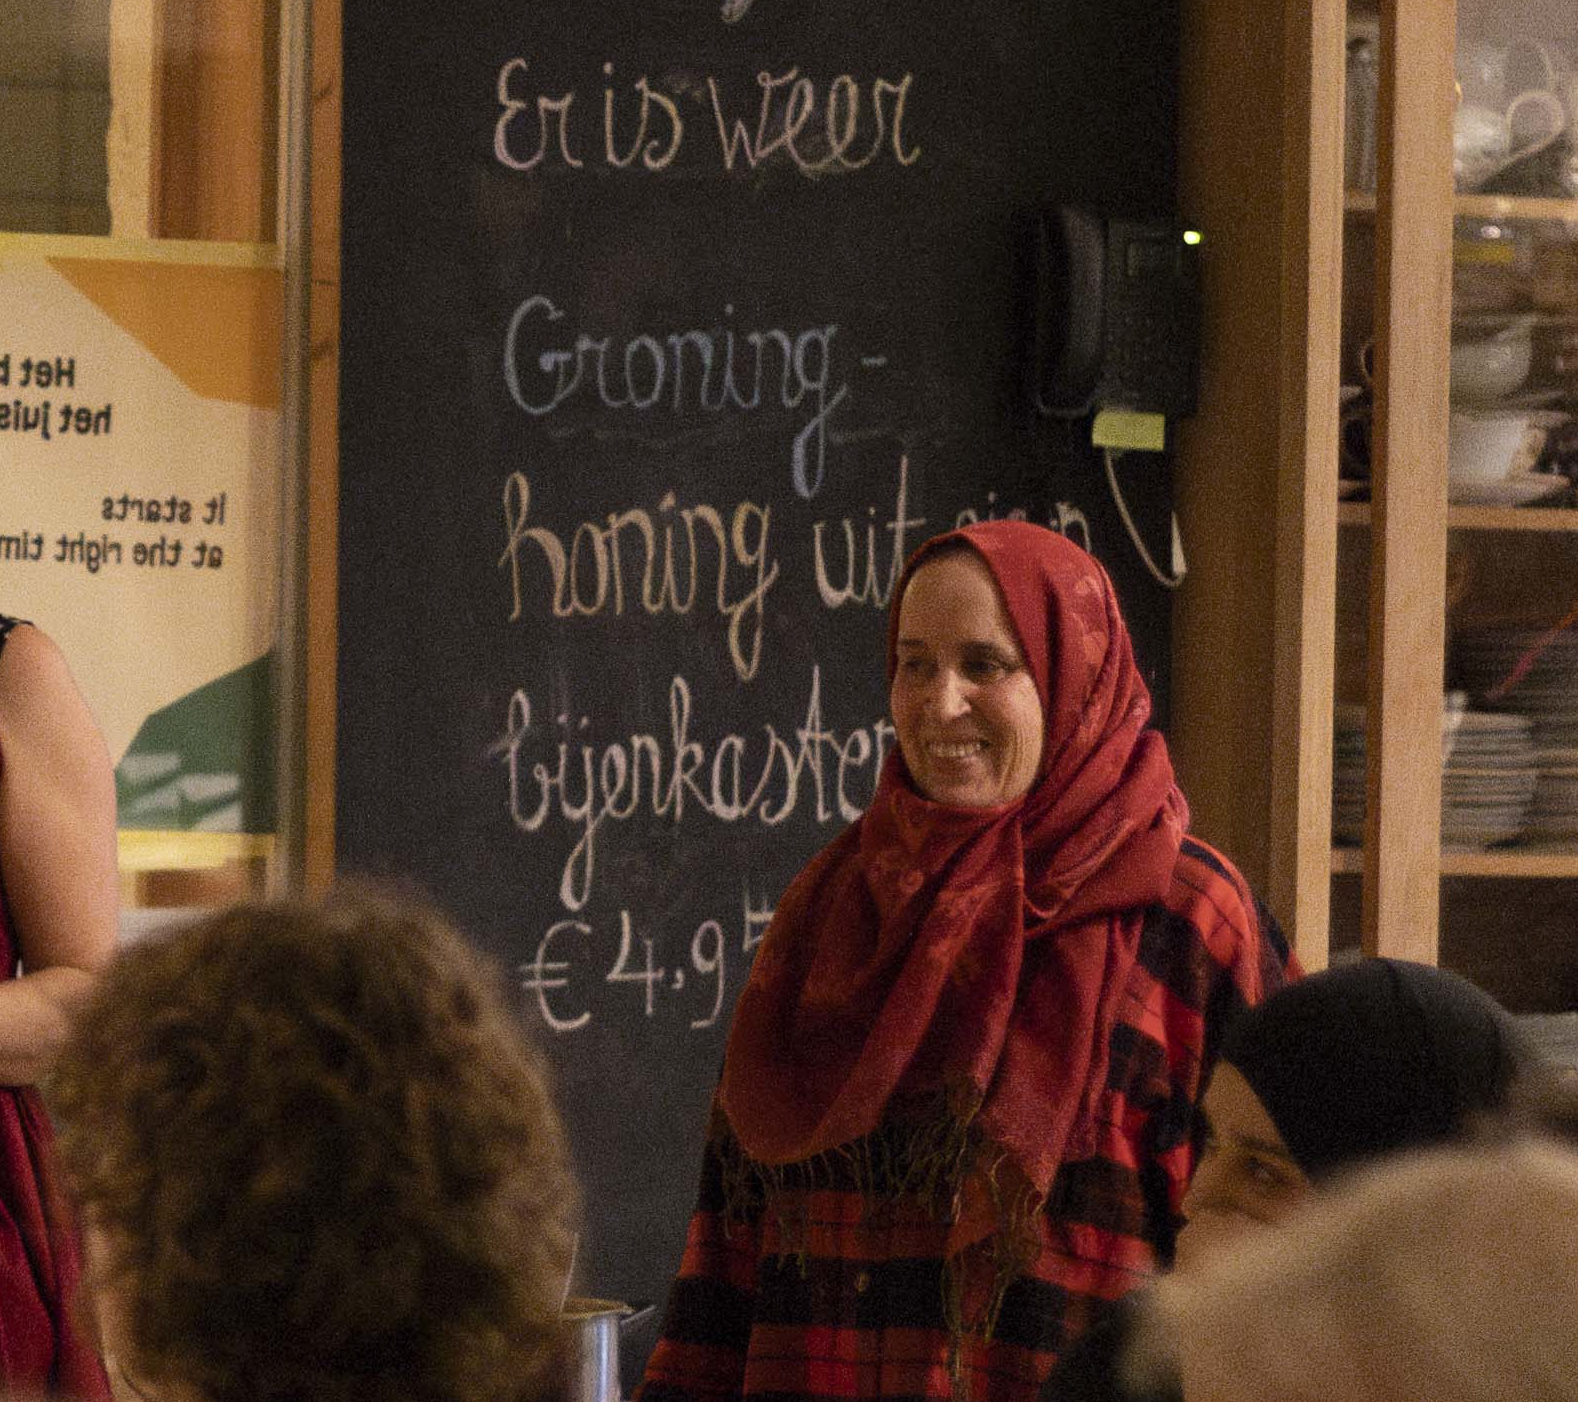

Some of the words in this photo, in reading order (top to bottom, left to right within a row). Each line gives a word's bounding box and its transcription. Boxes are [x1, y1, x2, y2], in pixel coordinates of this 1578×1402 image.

[494, 57, 584, 171] Er
[601, 60, 684, 171] is
[498, 470, 780, 683] honing
